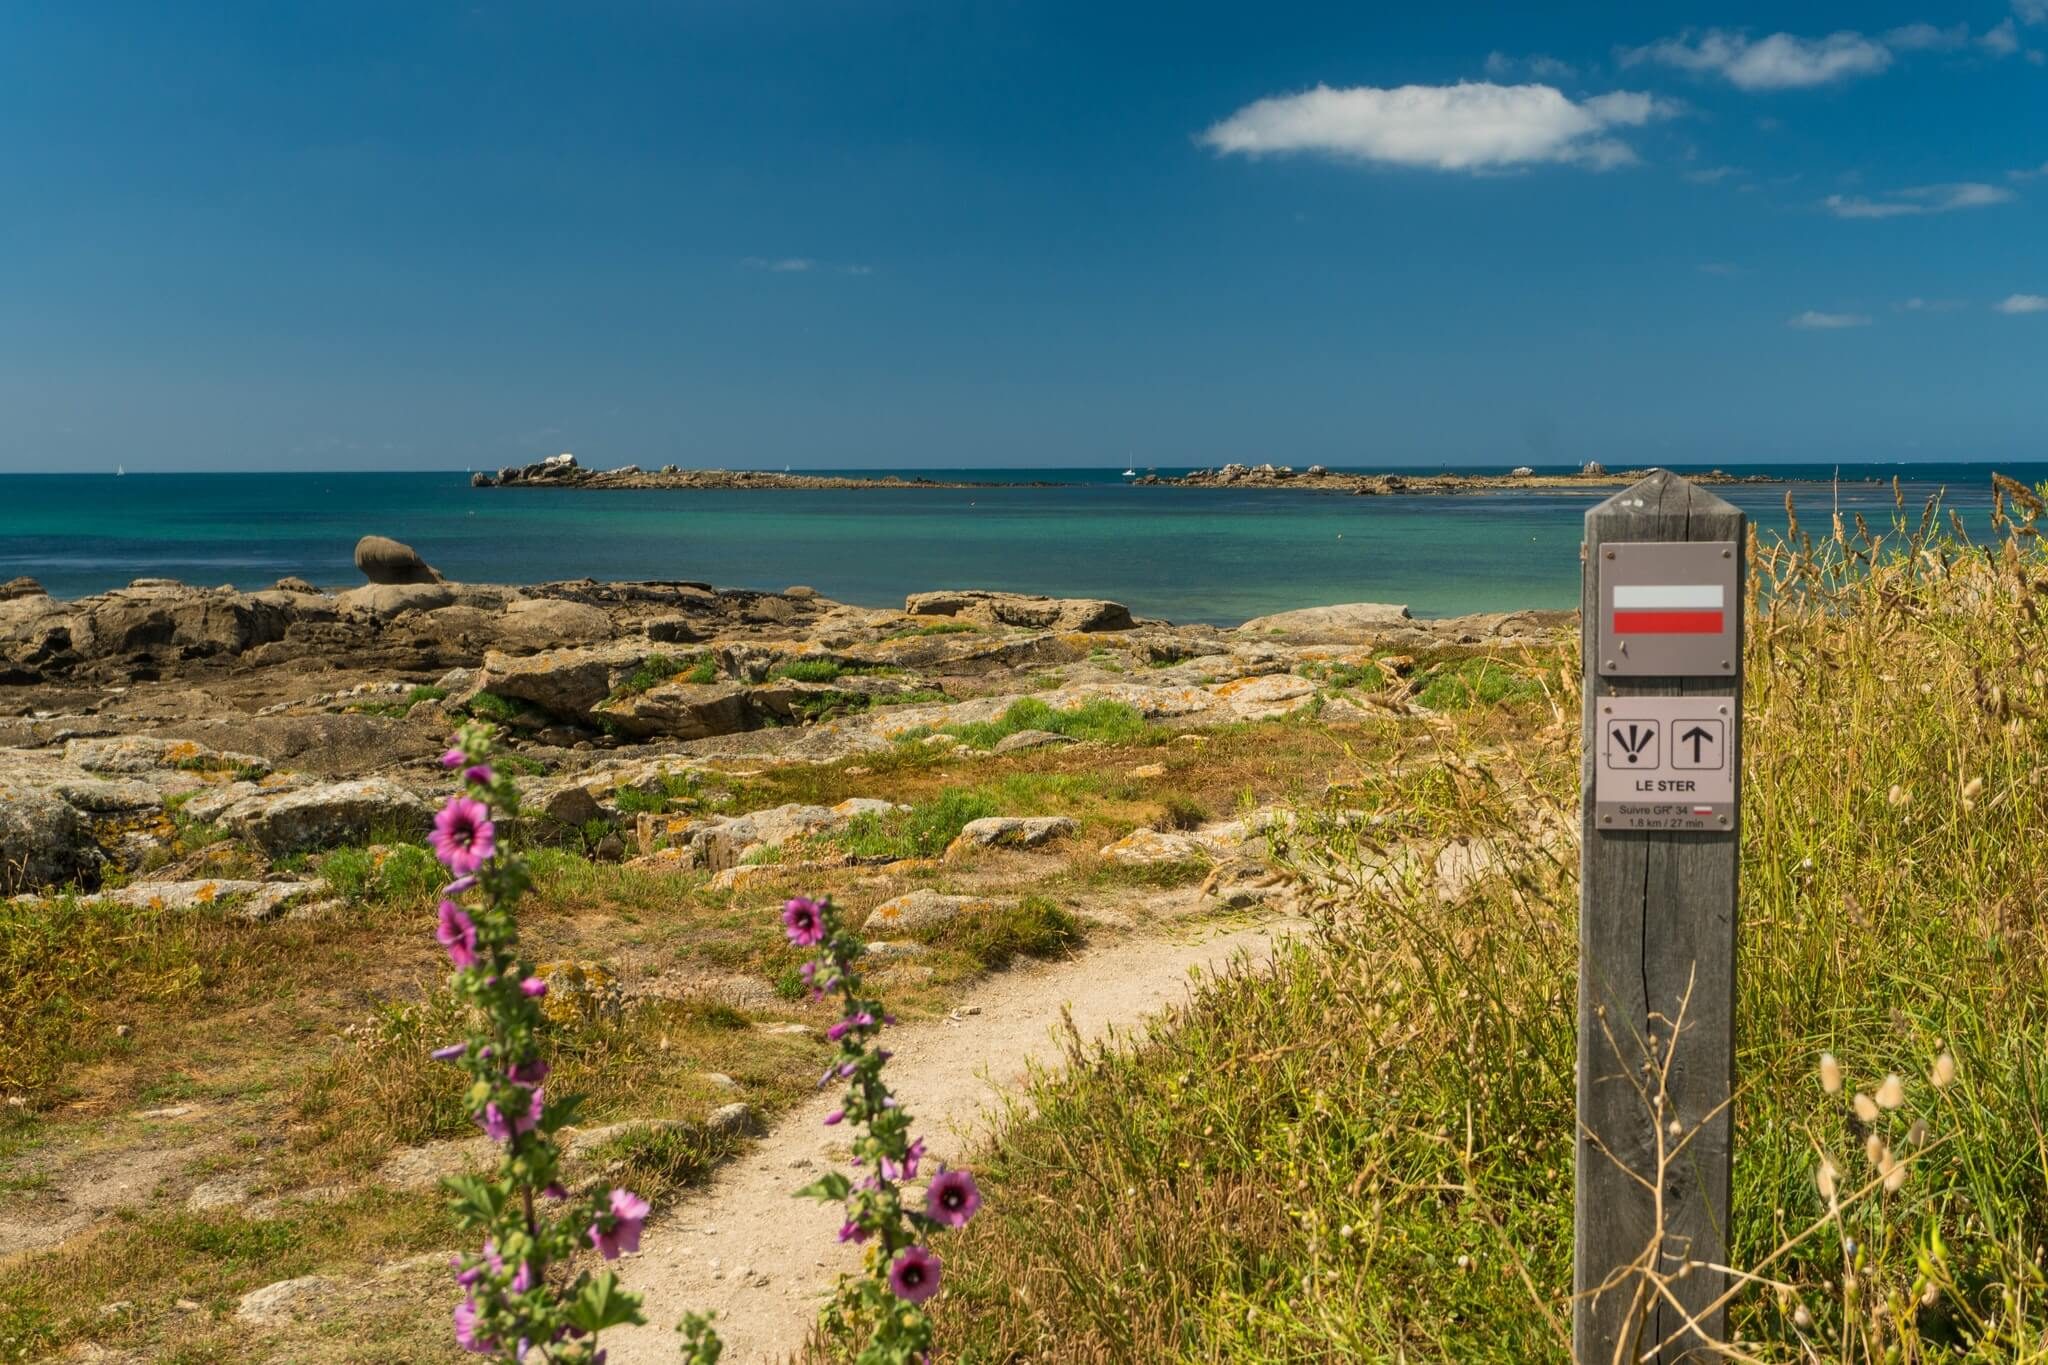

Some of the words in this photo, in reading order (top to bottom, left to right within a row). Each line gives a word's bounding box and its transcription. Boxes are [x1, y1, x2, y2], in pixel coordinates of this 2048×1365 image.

[1635, 780, 1654, 792] LE
[1657, 780, 1696, 792] STER
[1619, 805, 1651, 815] Suivre
[1676, 805, 1688, 815] 34
[1647, 818, 1662, 828] km
[1670, 818, 1682, 828] 27
[1686, 818, 1704, 828] min
